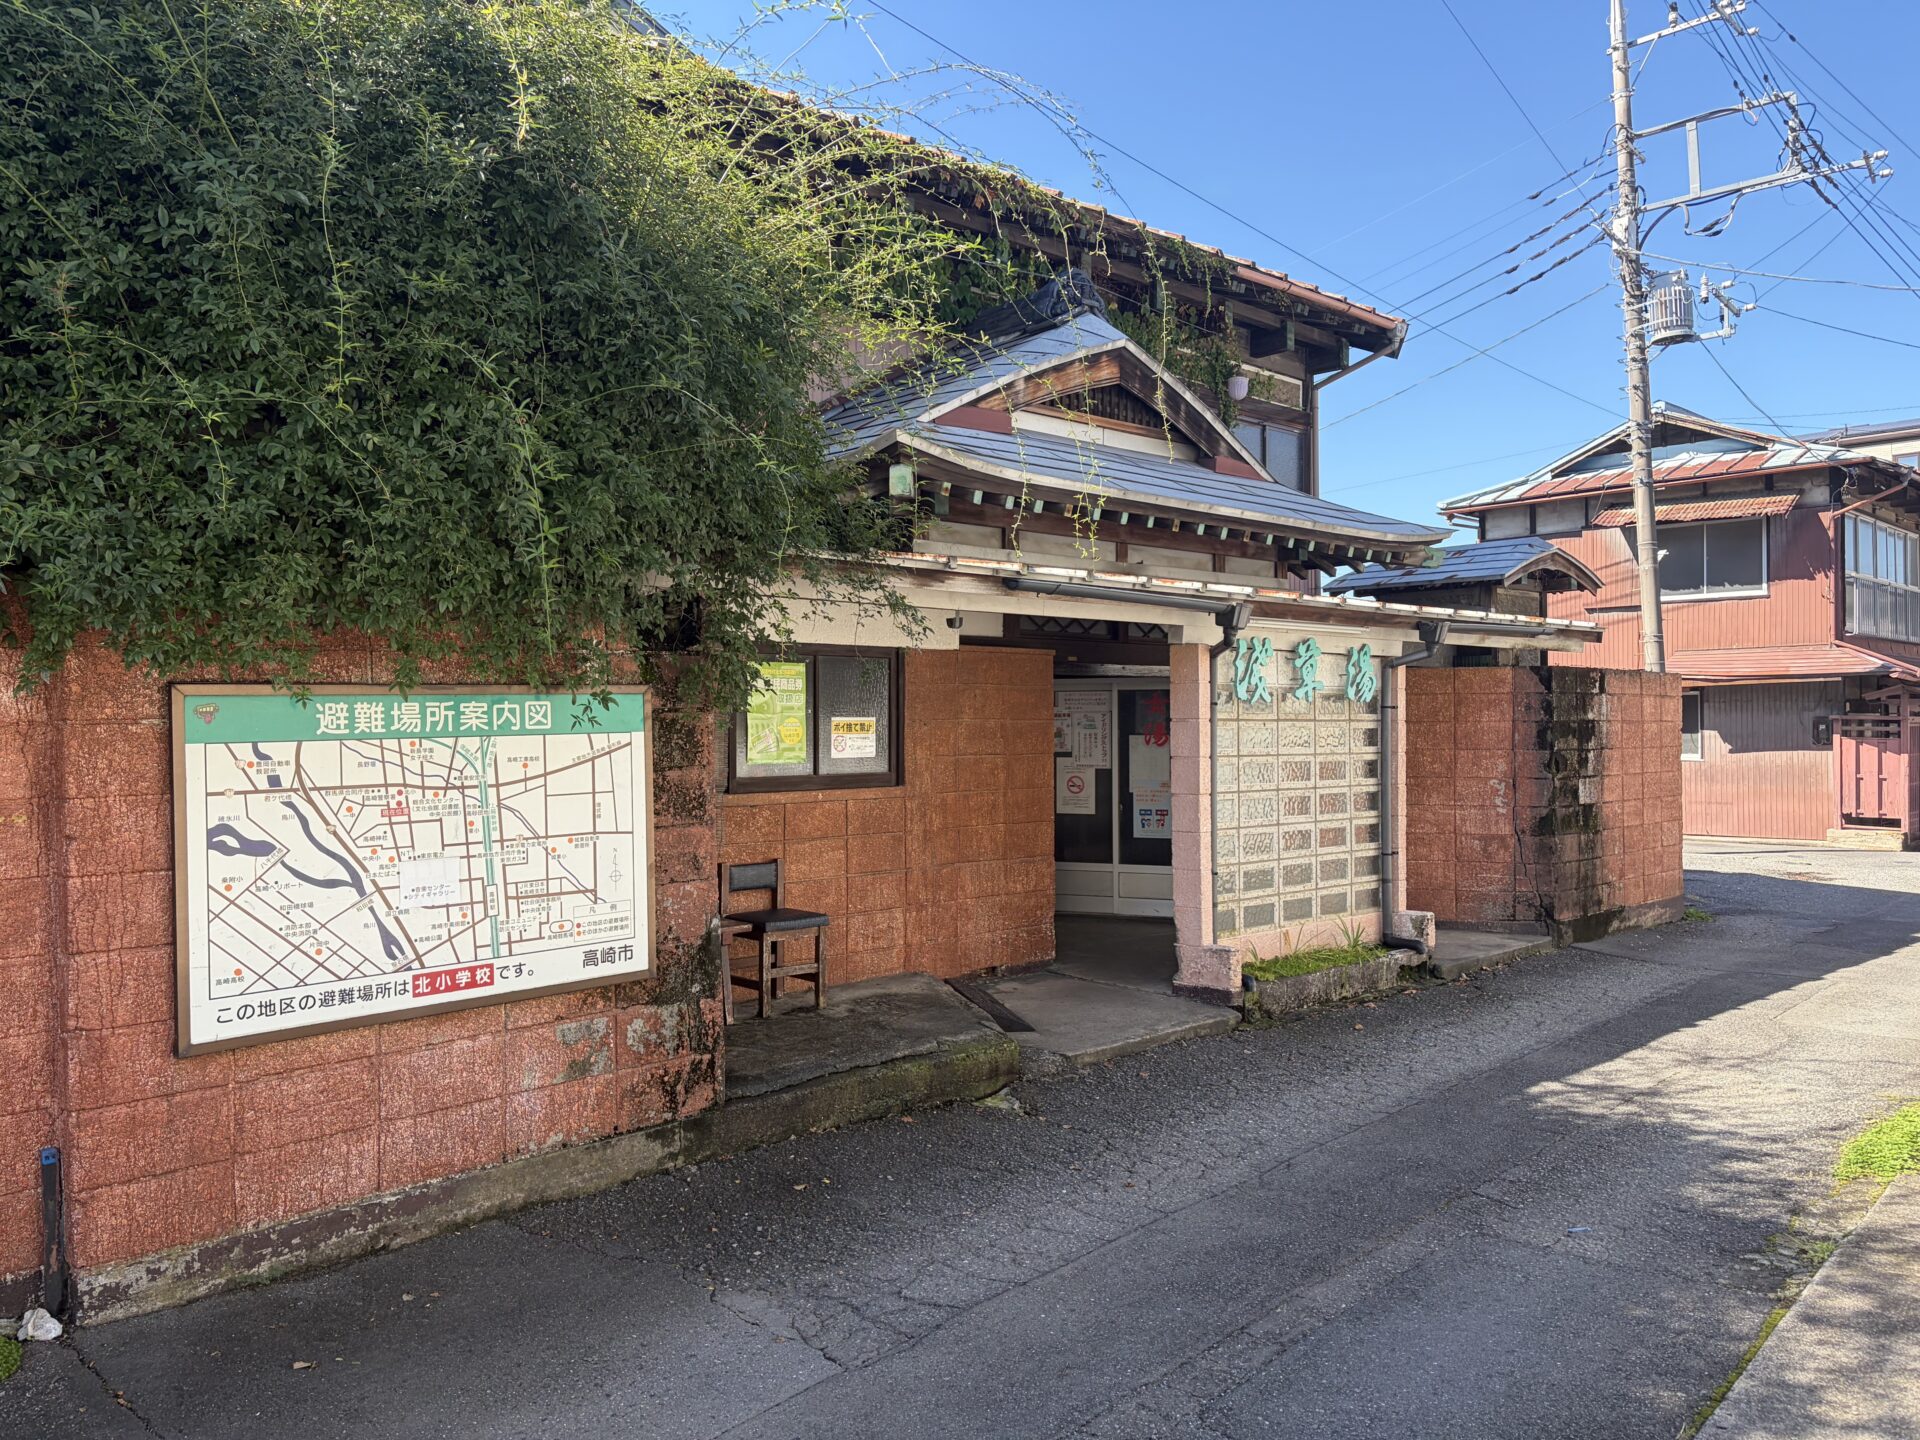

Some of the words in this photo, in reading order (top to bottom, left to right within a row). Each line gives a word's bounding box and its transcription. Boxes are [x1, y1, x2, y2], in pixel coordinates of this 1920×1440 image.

[315, 700, 552, 735] 避難場所案内図
[834, 722, 873, 732] ポイ捨て禁止
[256, 760, 290, 768] 豊岡自動車
[412, 797, 460, 805] 総合文化センター
[365, 870, 396, 879] 日本たばこ
[255, 882, 304, 892] 高崎ヘリポート
[415, 884, 451, 893] 音楽センター
[280, 902, 314, 911] 和田橋球場
[385, 908, 410, 917] 国立病院
[284, 922, 312, 931] 消防本部
[431, 920, 466, 930] 高崎市美術館
[582, 916, 629, 928] この地区の避難場所
[284, 929, 318, 938] 中央消防署
[582, 924, 629, 936] そのほかの避難場所
[418, 934, 443, 943] 高崎公園
[582, 943, 634, 969] 高崎市
[215, 975, 245, 986] 高崎高校
